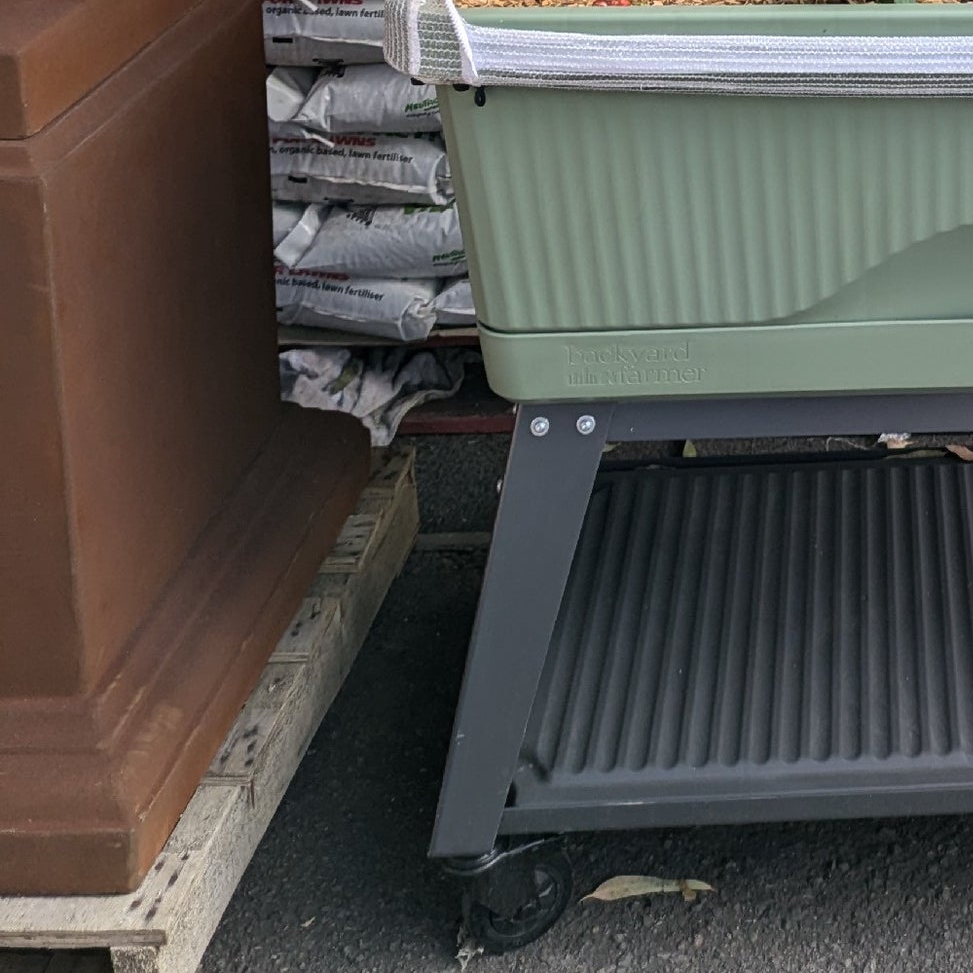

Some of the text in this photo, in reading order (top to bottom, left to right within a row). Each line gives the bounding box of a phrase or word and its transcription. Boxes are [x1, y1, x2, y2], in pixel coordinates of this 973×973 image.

[335, 8, 358, 18] lawn
[360, 8, 385, 19] fertil
[329, 136, 377, 147] WNS
[279, 147, 314, 155] organic
[317, 147, 346, 157] based,
[349, 149, 371, 159] lawn
[373, 151, 413, 164] fertiliser
[345, 286, 384, 301] fertiliser
[564, 341, 690, 368] backyard
